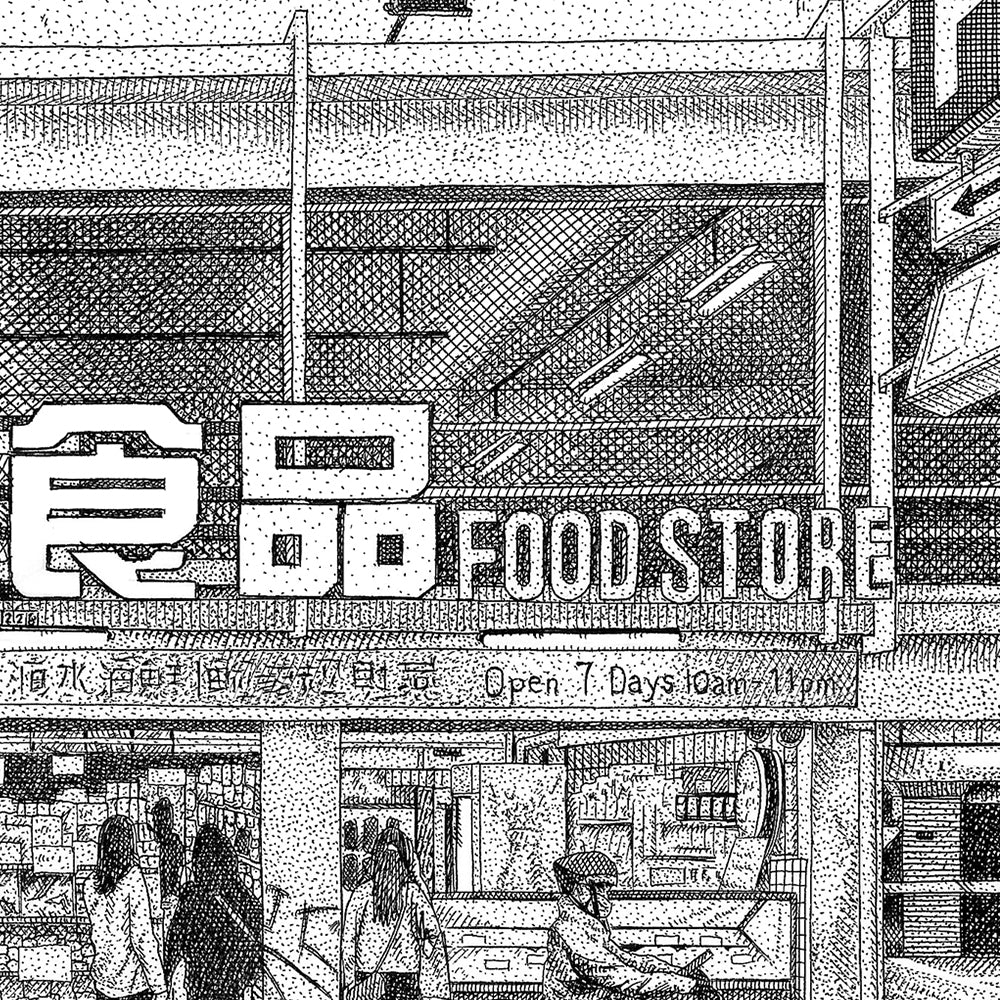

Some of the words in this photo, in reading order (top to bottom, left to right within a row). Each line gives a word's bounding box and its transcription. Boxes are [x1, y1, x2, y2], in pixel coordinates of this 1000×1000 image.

[458, 508, 639, 601] FOOD
[660, 507, 896, 604] STORE
[484, 666, 559, 700] Open
[575, 661, 594, 696] 7
[609, 667, 674, 701] Days
